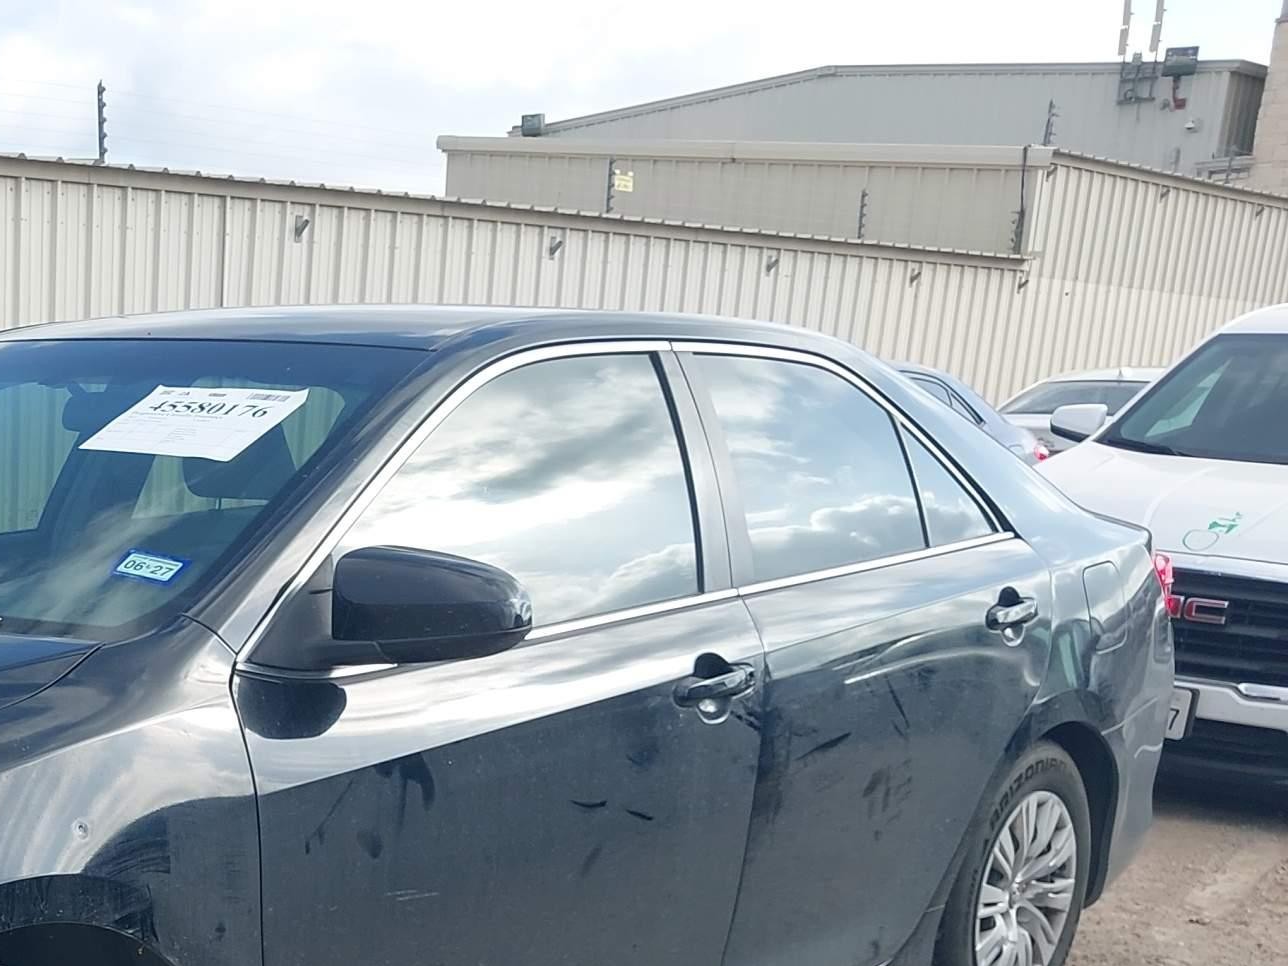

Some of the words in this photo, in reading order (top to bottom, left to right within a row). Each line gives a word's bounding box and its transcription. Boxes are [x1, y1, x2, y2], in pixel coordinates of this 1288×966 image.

[149, 400, 274, 418] 45580176
[123, 559, 147, 571] 06
[150, 565, 175, 577] 27
